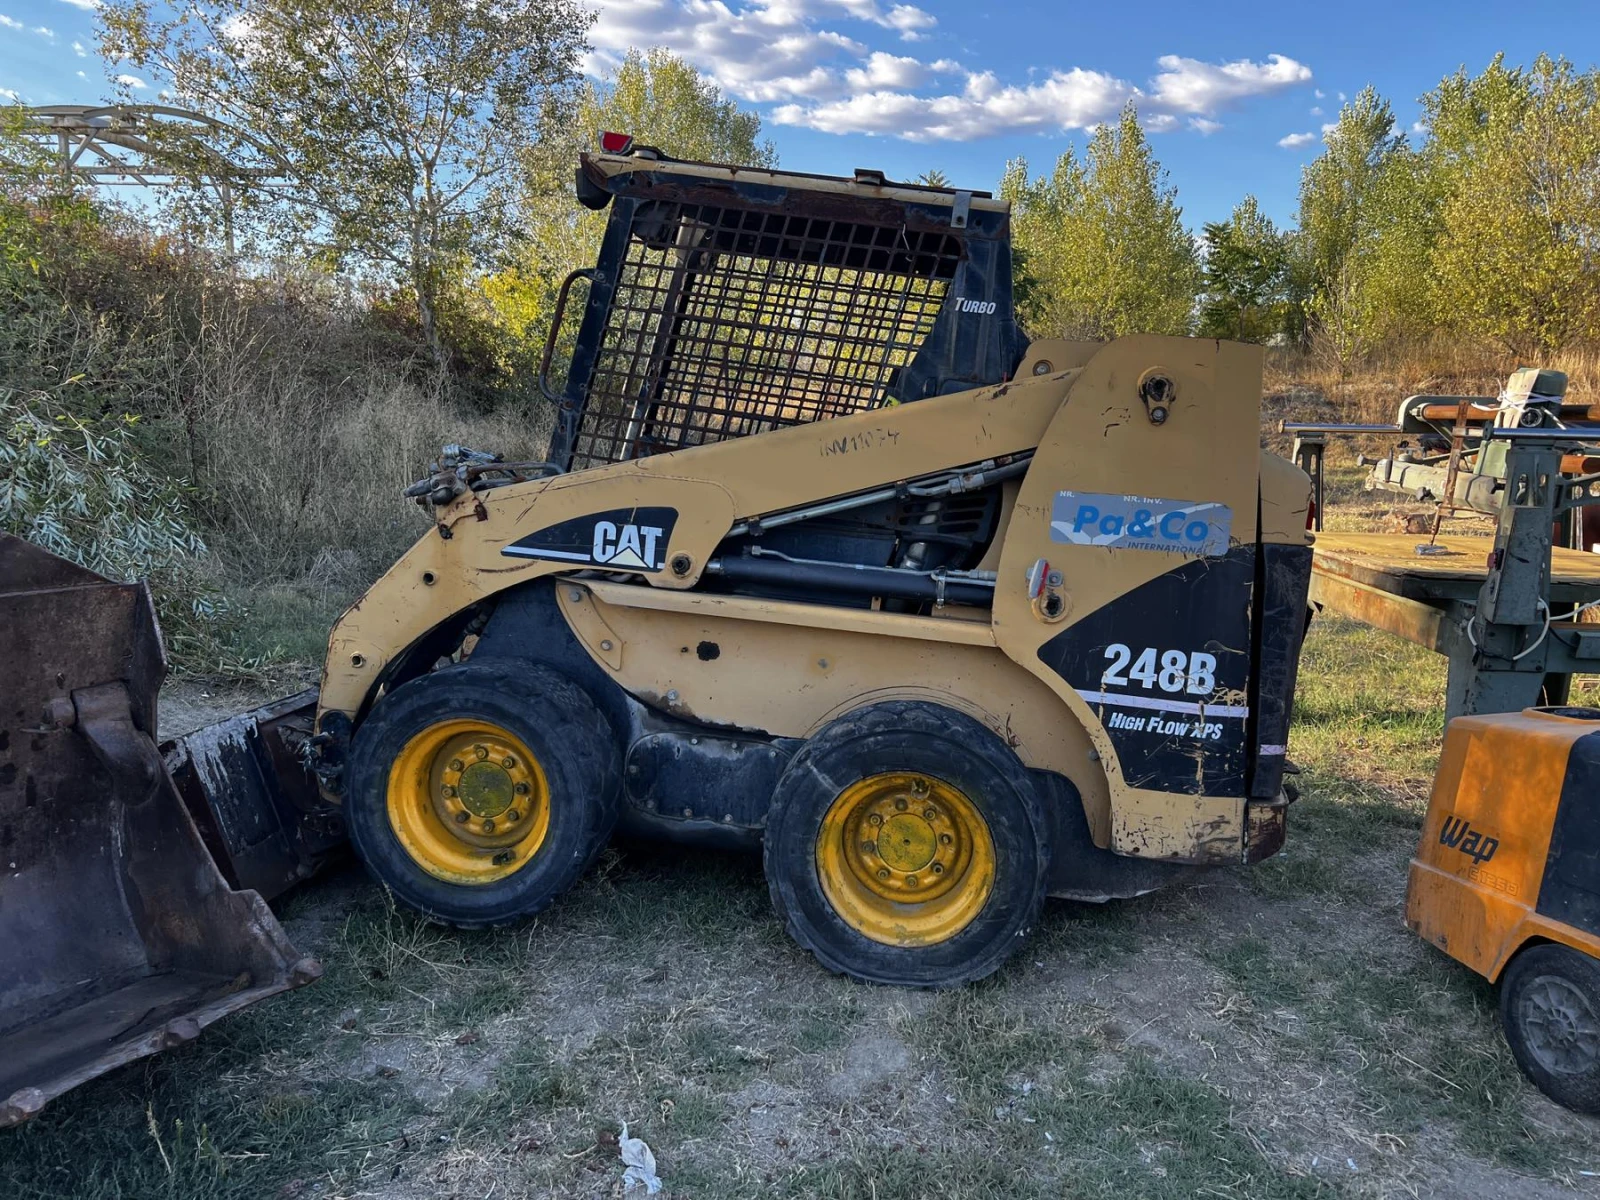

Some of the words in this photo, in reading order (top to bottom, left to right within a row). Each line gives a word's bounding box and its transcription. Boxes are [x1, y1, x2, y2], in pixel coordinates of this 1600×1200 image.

[955, 297, 996, 315] TURBO
[1059, 490, 1075, 498] NR.
[1123, 495, 1141, 503] NR.
[1143, 497, 1163, 505] INV.
[1072, 505, 1209, 542] Pa&Co
[592, 521, 663, 569] CAT
[1127, 541, 1209, 555] INTERNATIONAL
[1101, 643, 1217, 695] 248B
[1108, 712, 1146, 731] HIGH
[1147, 716, 1189, 736] FLOW
[1190, 722, 1224, 740] XPS
[1439, 815, 1500, 865] Wap
